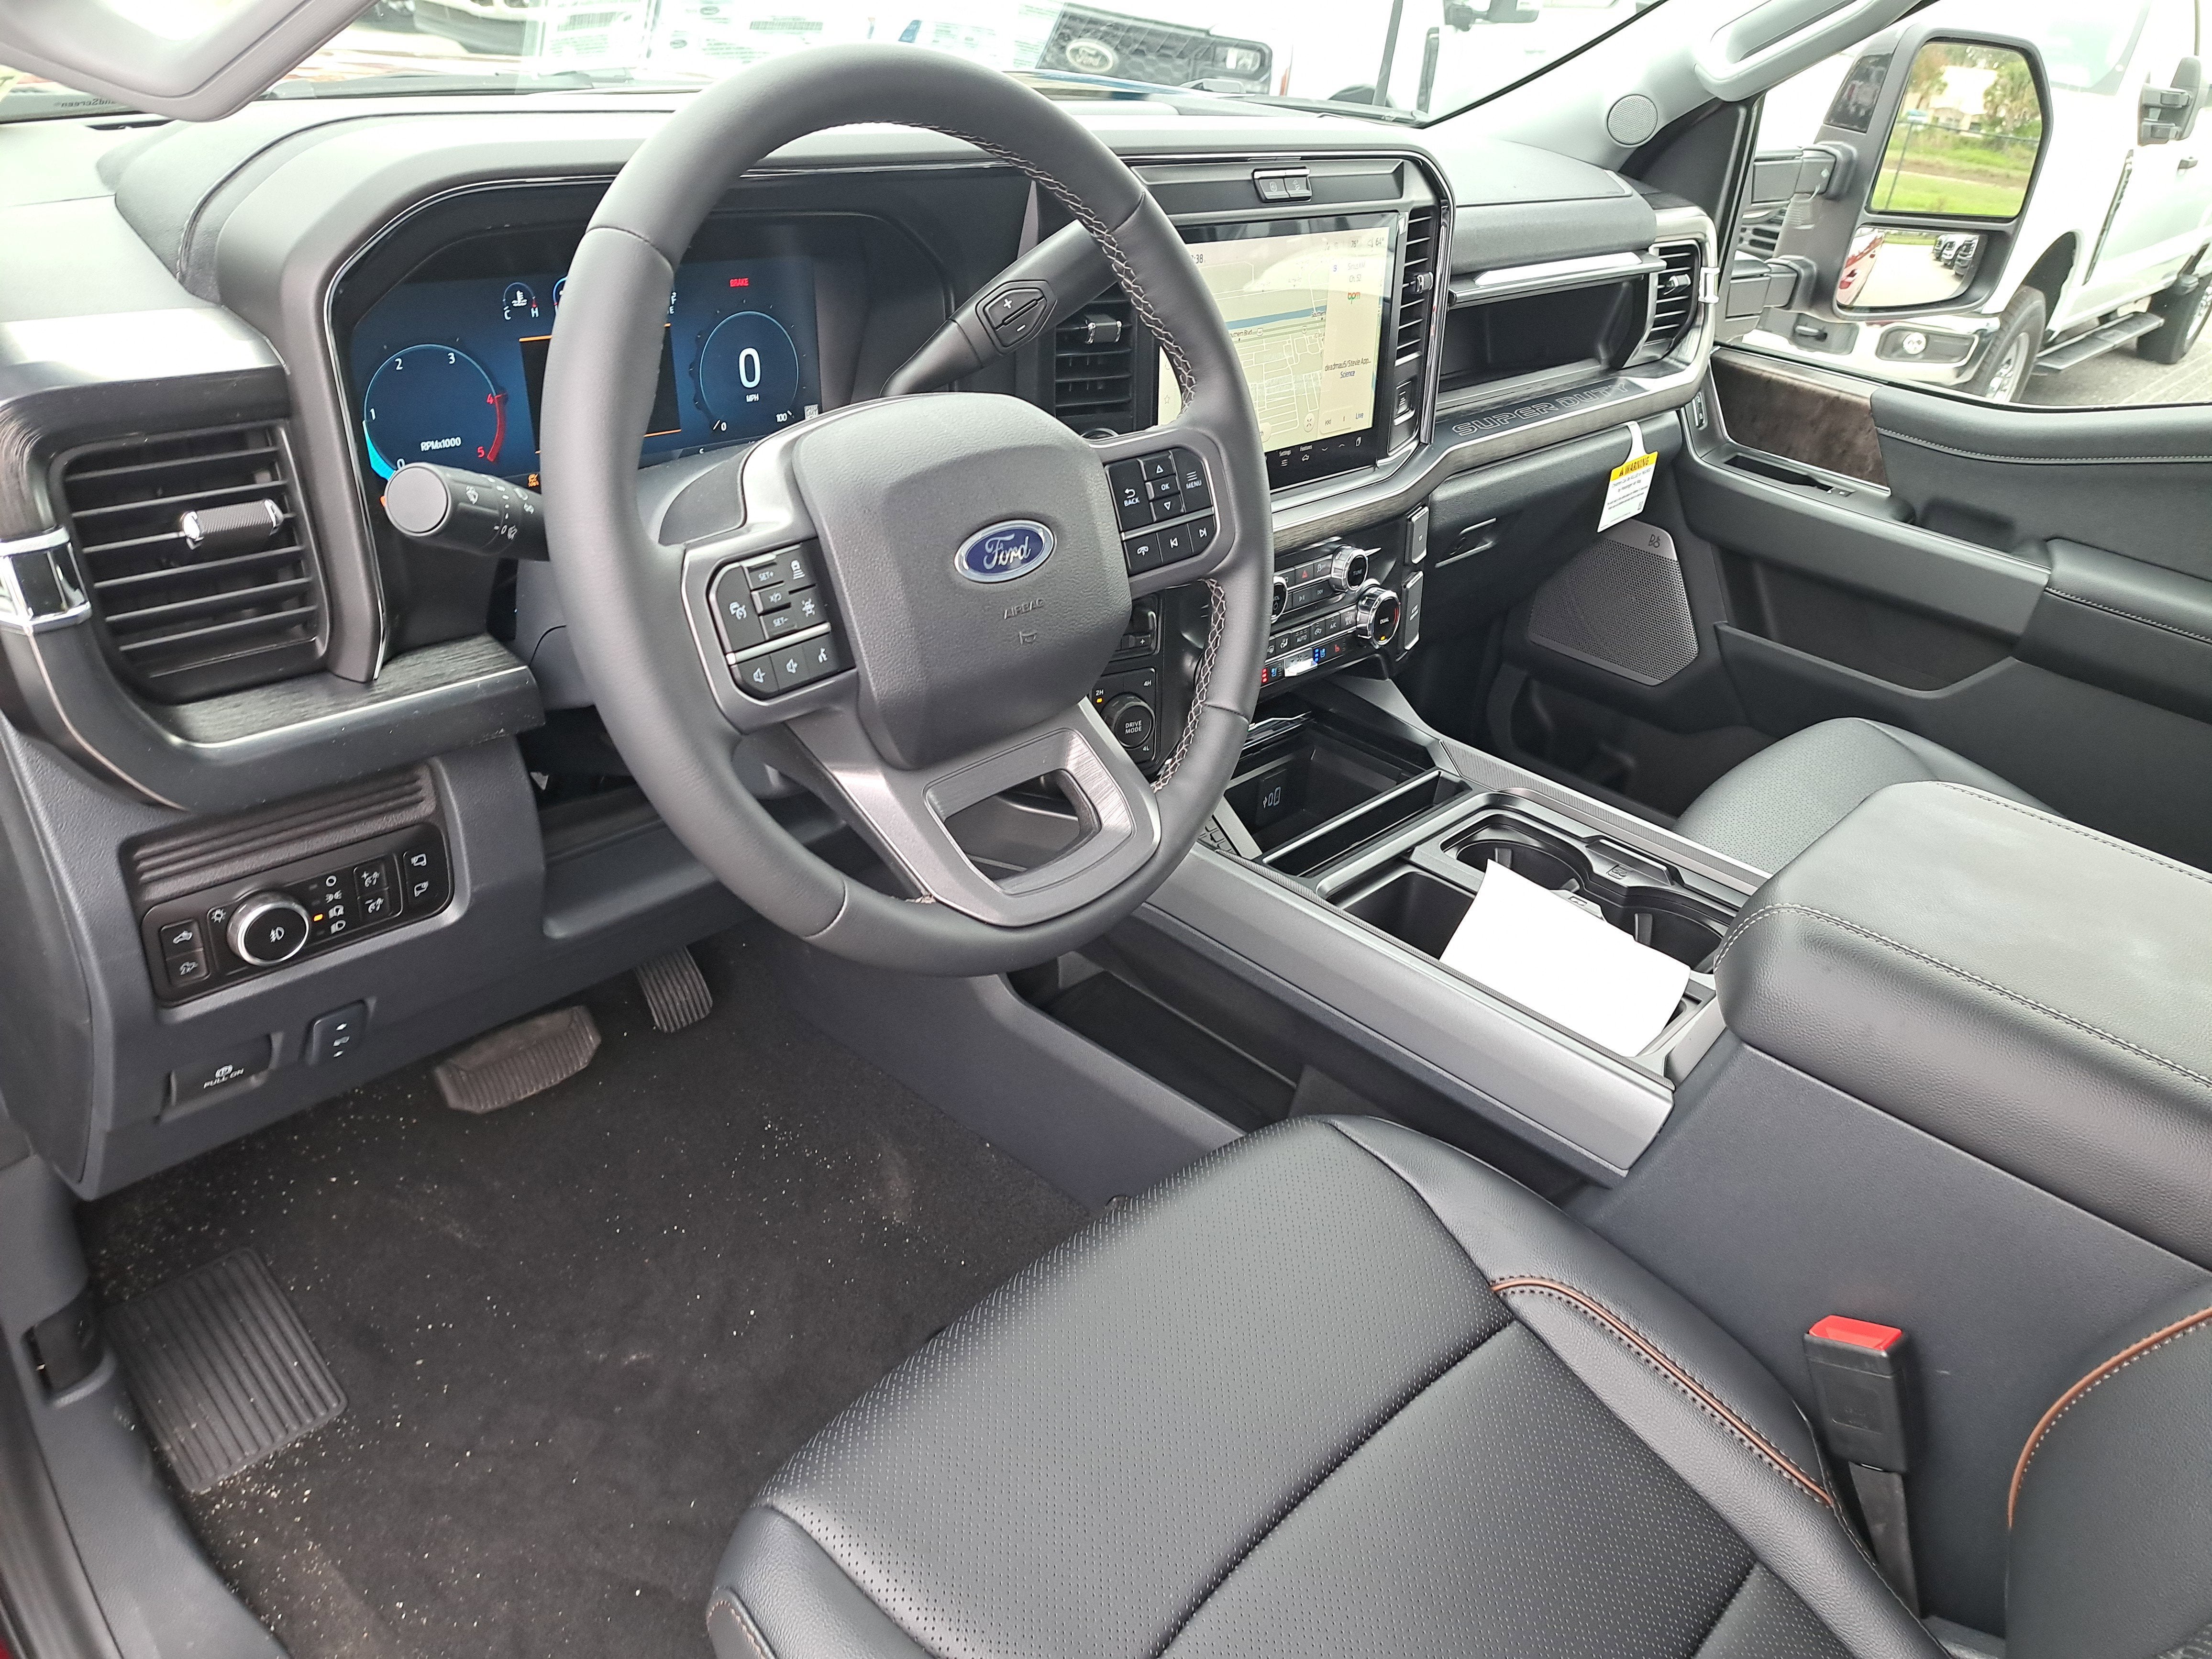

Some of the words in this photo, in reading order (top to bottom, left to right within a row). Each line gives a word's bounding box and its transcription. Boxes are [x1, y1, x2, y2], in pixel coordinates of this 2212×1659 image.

[730, 277, 749, 287] BRAKE
[504, 309, 511, 320] C
[531, 308, 539, 318] H
[448, 353, 455, 364] 3
[395, 358, 403, 371] 2
[739, 348, 761, 389] 0
[1340, 370, 1356, 379] Science
[487, 394, 495, 404] 4
[746, 393, 759, 402] MPH
[370, 409, 376, 420] 1
[1452, 402, 1558, 436] SUPER
[1555, 383, 1628, 408] DUTY
[776, 413, 787, 422] 100
[720, 422, 727, 431] 0
[477, 446, 485, 458] 5
[1625, 456, 1649, 475] WARNING
[1161, 483, 1171, 491] OK
[1186, 479, 1203, 489] MENU
[1124, 497, 1140, 507] BACK
[983, 533, 1031, 570] Ford
[1125, 719, 1142, 729] DRIVE
[1125, 726, 1142, 735] MODE
[203, 1076, 228, 1089] PULL
[230, 1068, 244, 1079] ON
